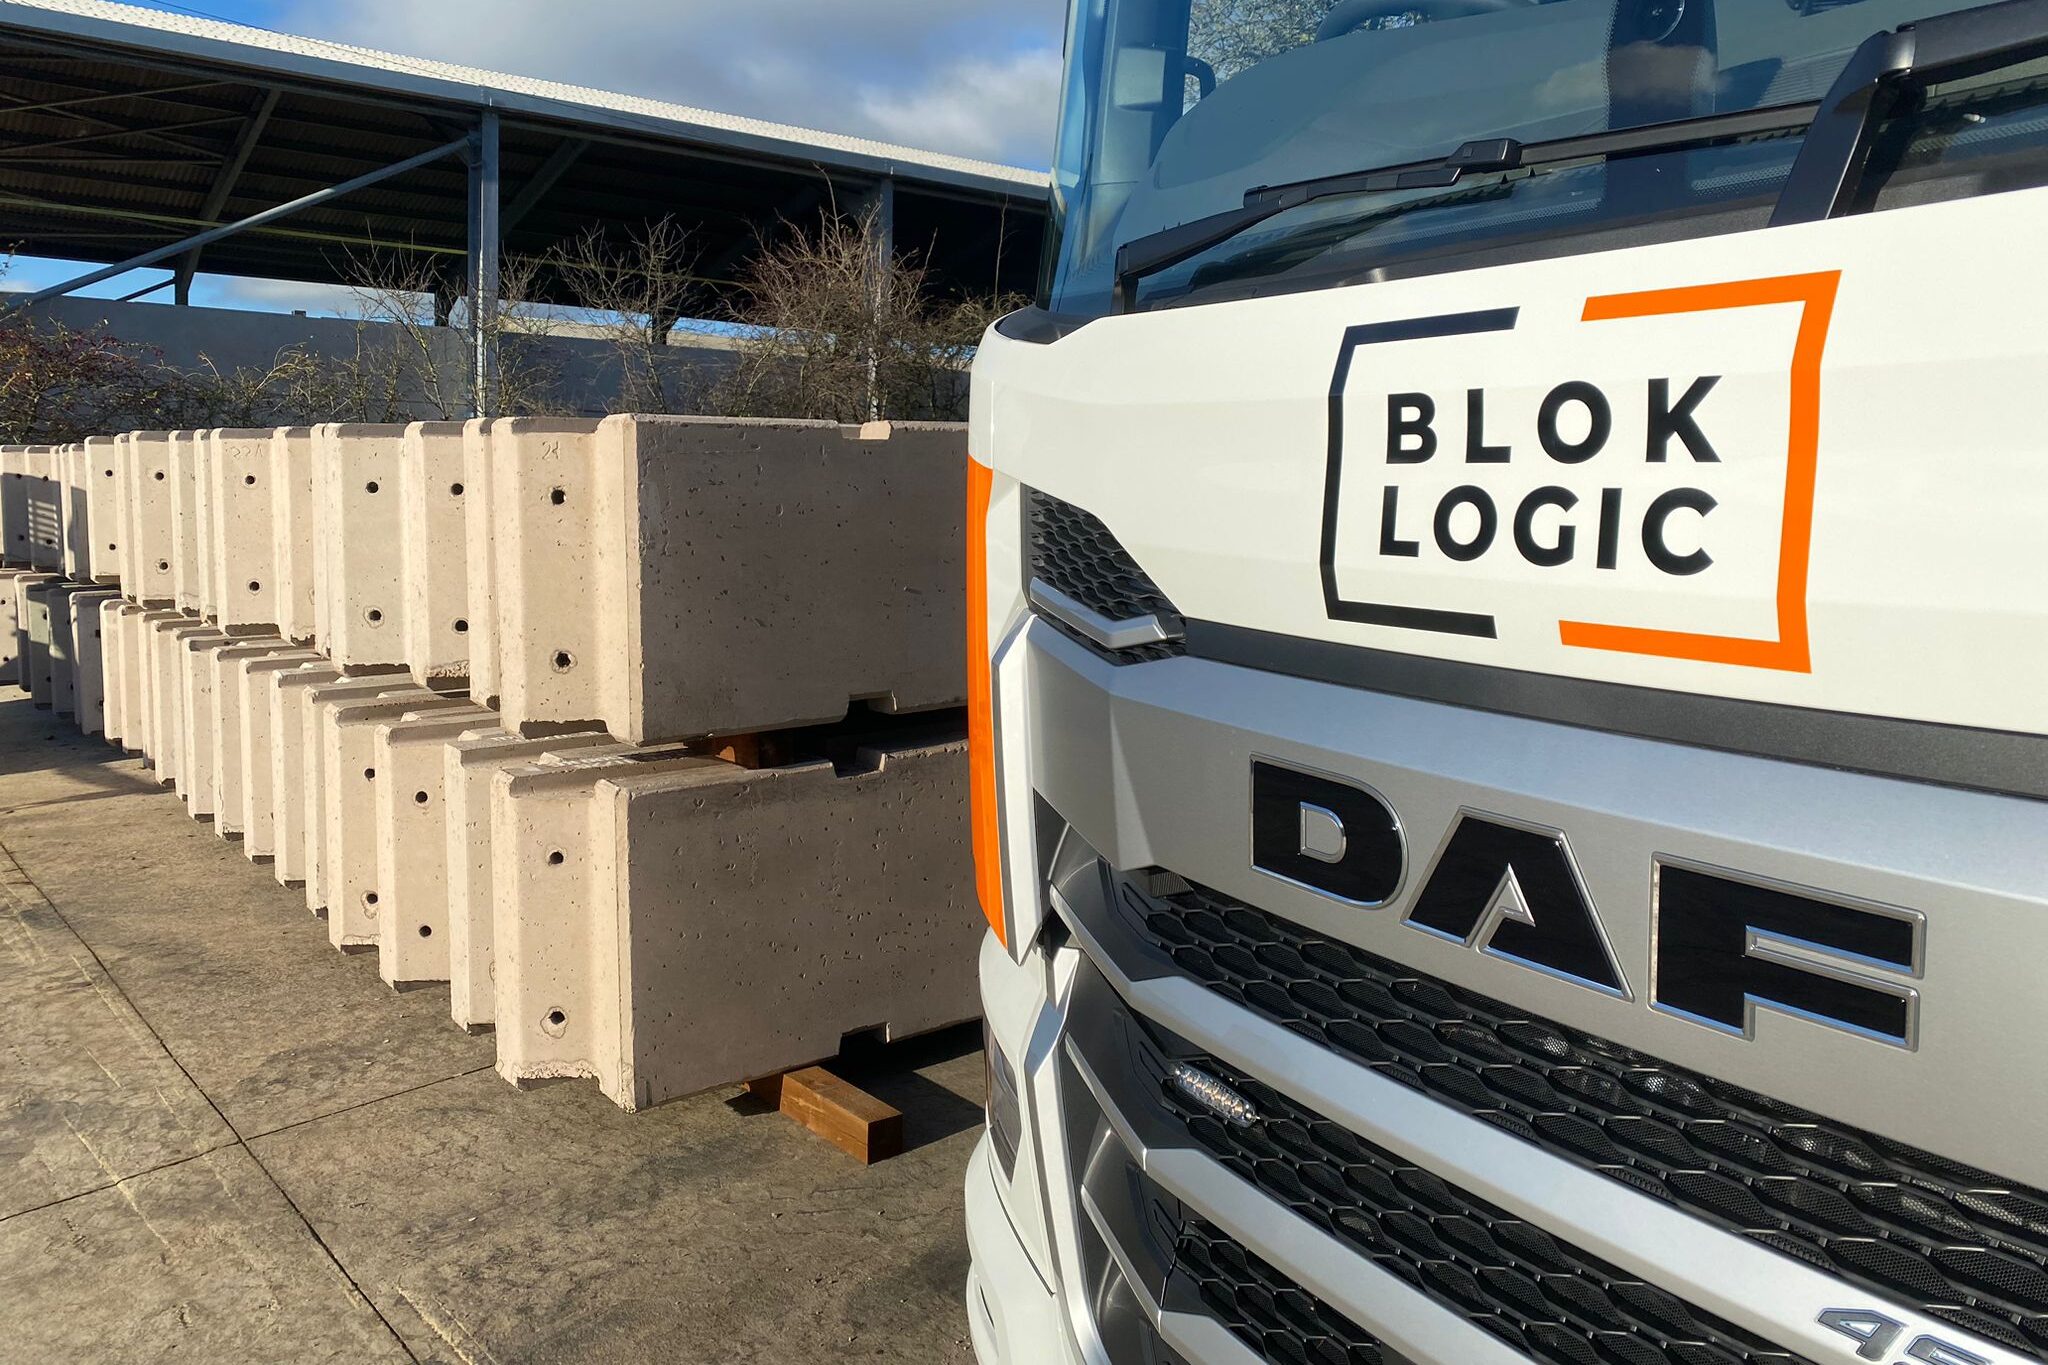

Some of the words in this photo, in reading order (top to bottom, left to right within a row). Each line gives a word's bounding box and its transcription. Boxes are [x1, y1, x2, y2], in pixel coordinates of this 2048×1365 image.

[1386, 375, 1722, 464] BLOK
[1379, 484, 1719, 576] LOGIC
[1248, 752, 1928, 1052] DAF
